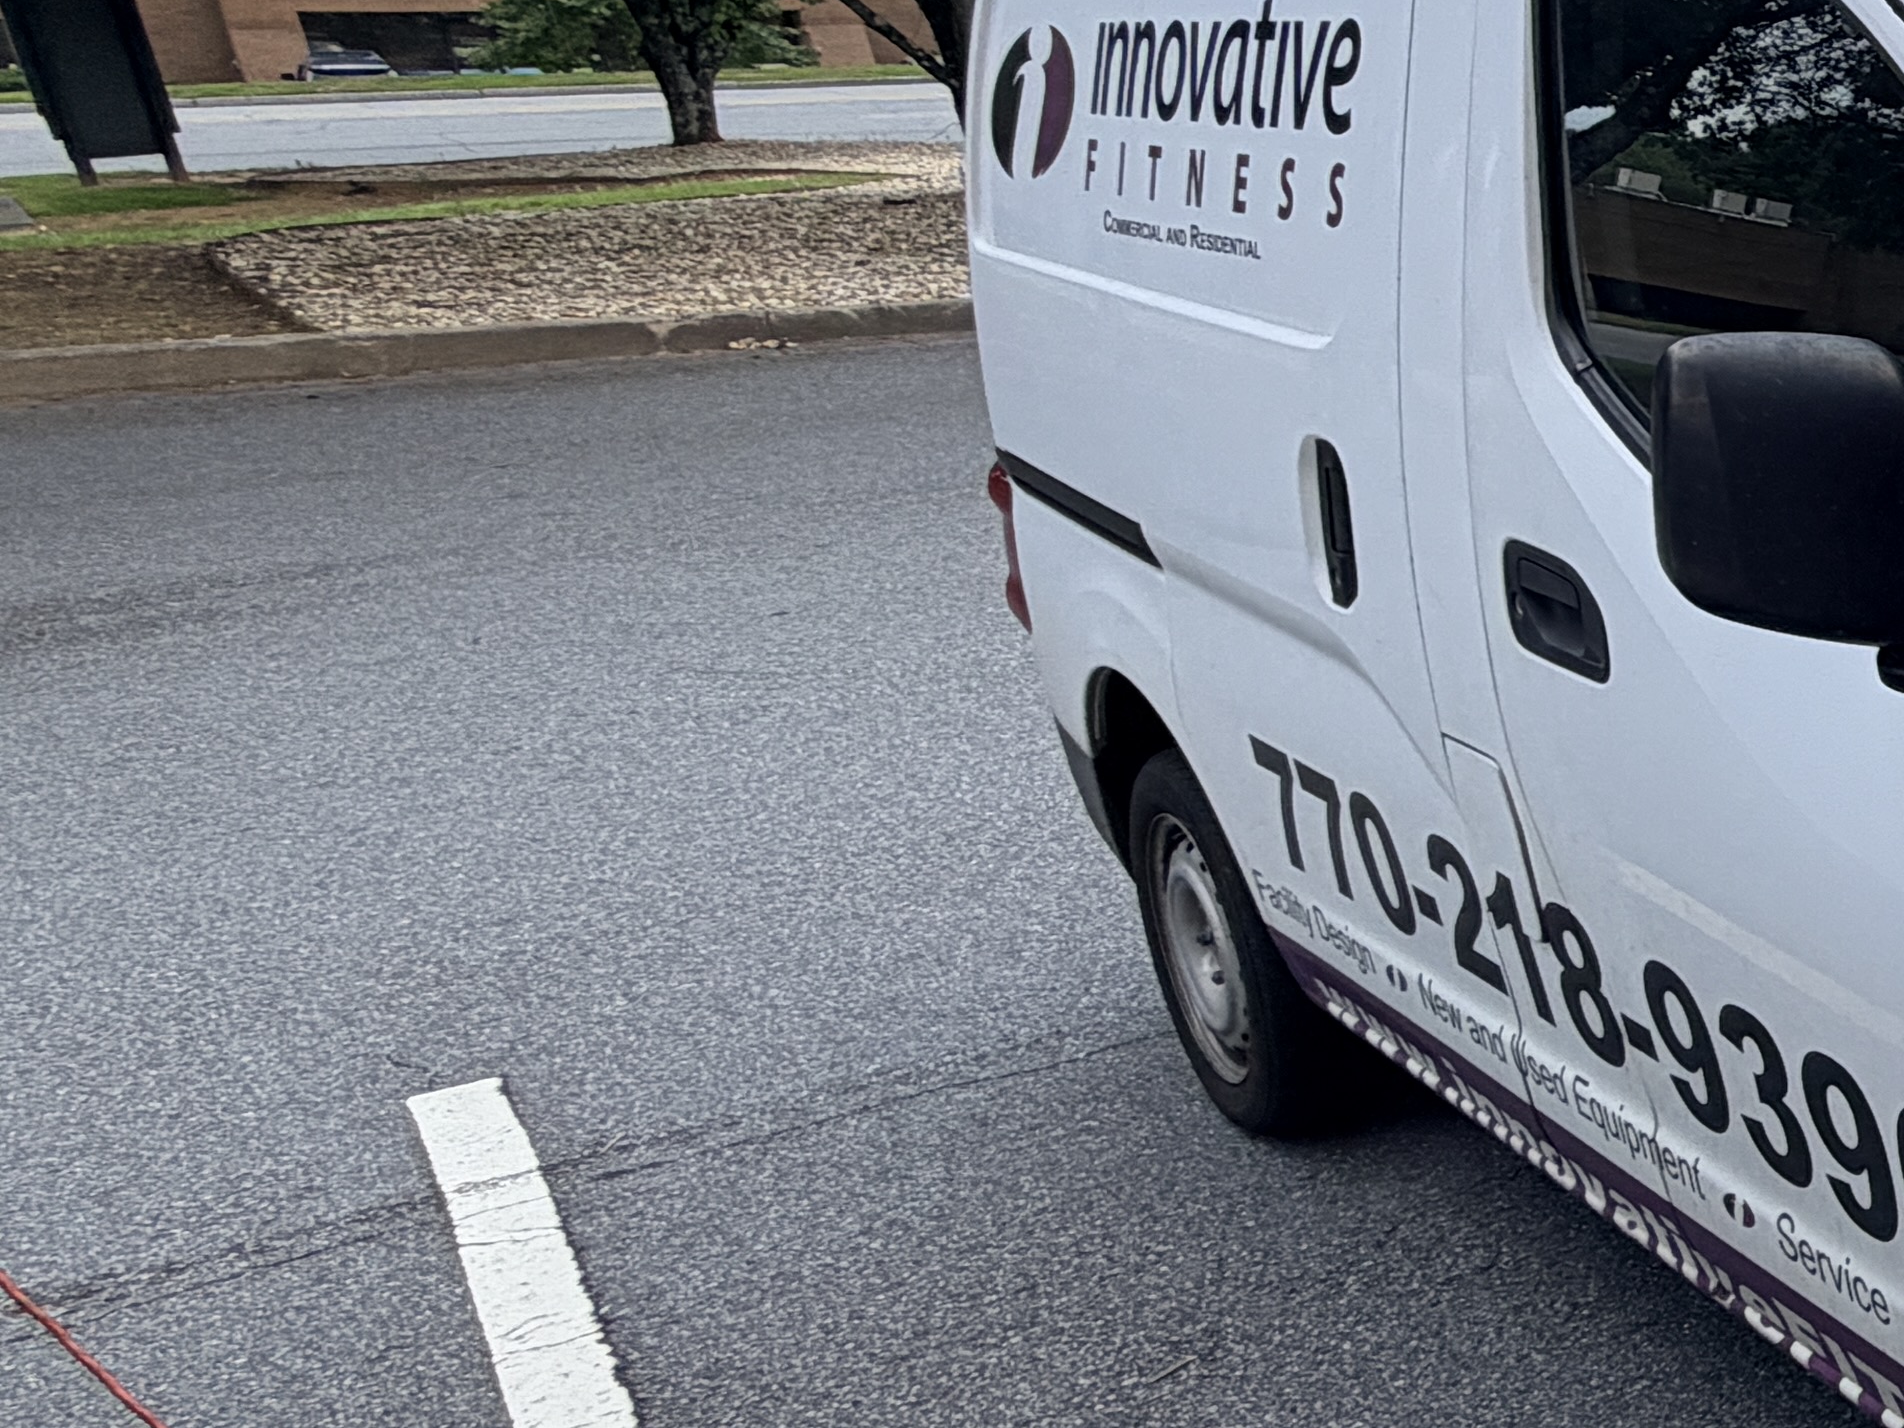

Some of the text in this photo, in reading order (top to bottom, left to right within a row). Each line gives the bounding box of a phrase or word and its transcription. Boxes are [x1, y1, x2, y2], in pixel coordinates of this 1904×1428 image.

[1084, 138, 1347, 229] FITNESS
[1251, 867, 1313, 939] Facility
[1312, 904, 1378, 976] Design
[1418, 973, 1462, 1034] New
[1466, 1015, 1507, 1064] and
[1511, 1032, 1569, 1106] Used
[1572, 1074, 1706, 1200] Equipment
[1776, 1212, 1892, 1327] Service
